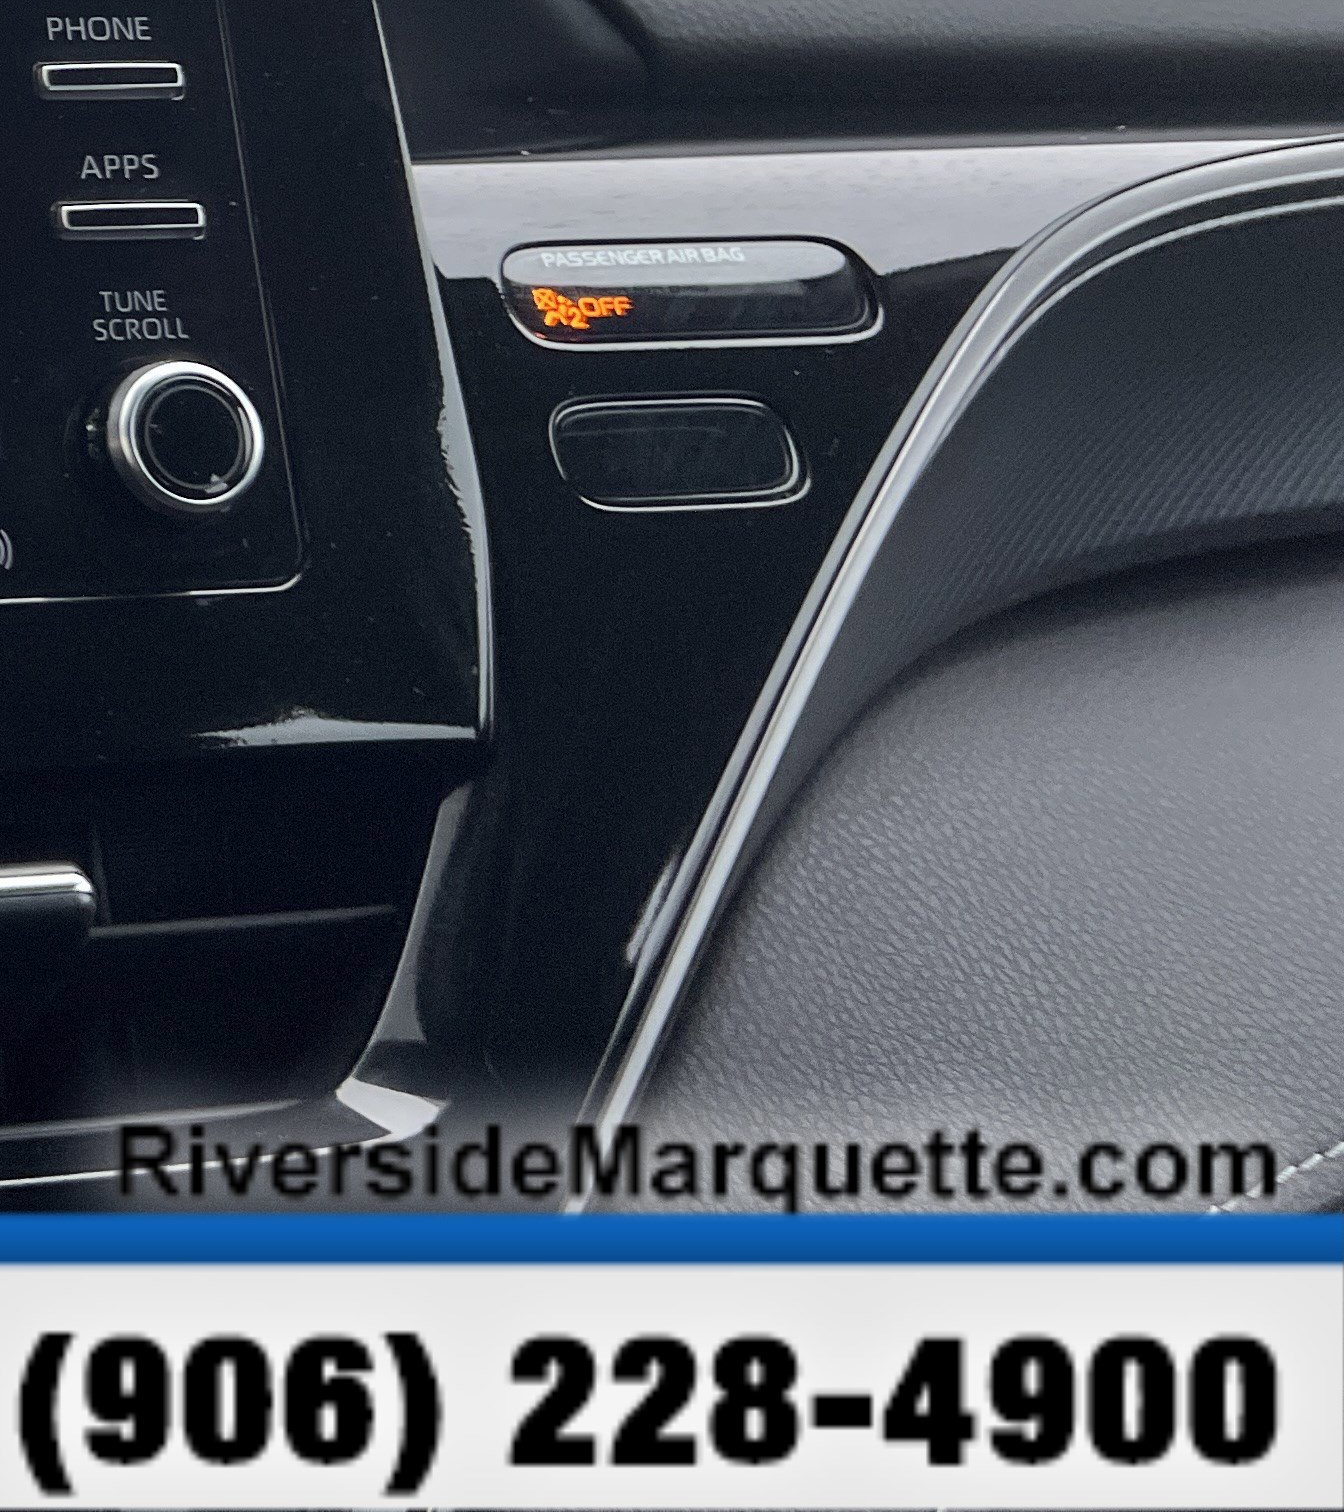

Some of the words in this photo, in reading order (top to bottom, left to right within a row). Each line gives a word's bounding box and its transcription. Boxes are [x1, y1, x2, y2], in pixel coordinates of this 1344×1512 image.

[45, 15, 153, 41] PHONE
[80, 153, 161, 180] APPS
[540, 248, 664, 268] PASSENGER
[666, 248, 701, 265] AIR
[702, 246, 746, 264] BAG
[98, 289, 168, 313] TUNE
[578, 295, 633, 317] OFF
[92, 317, 190, 342] SCROLL
